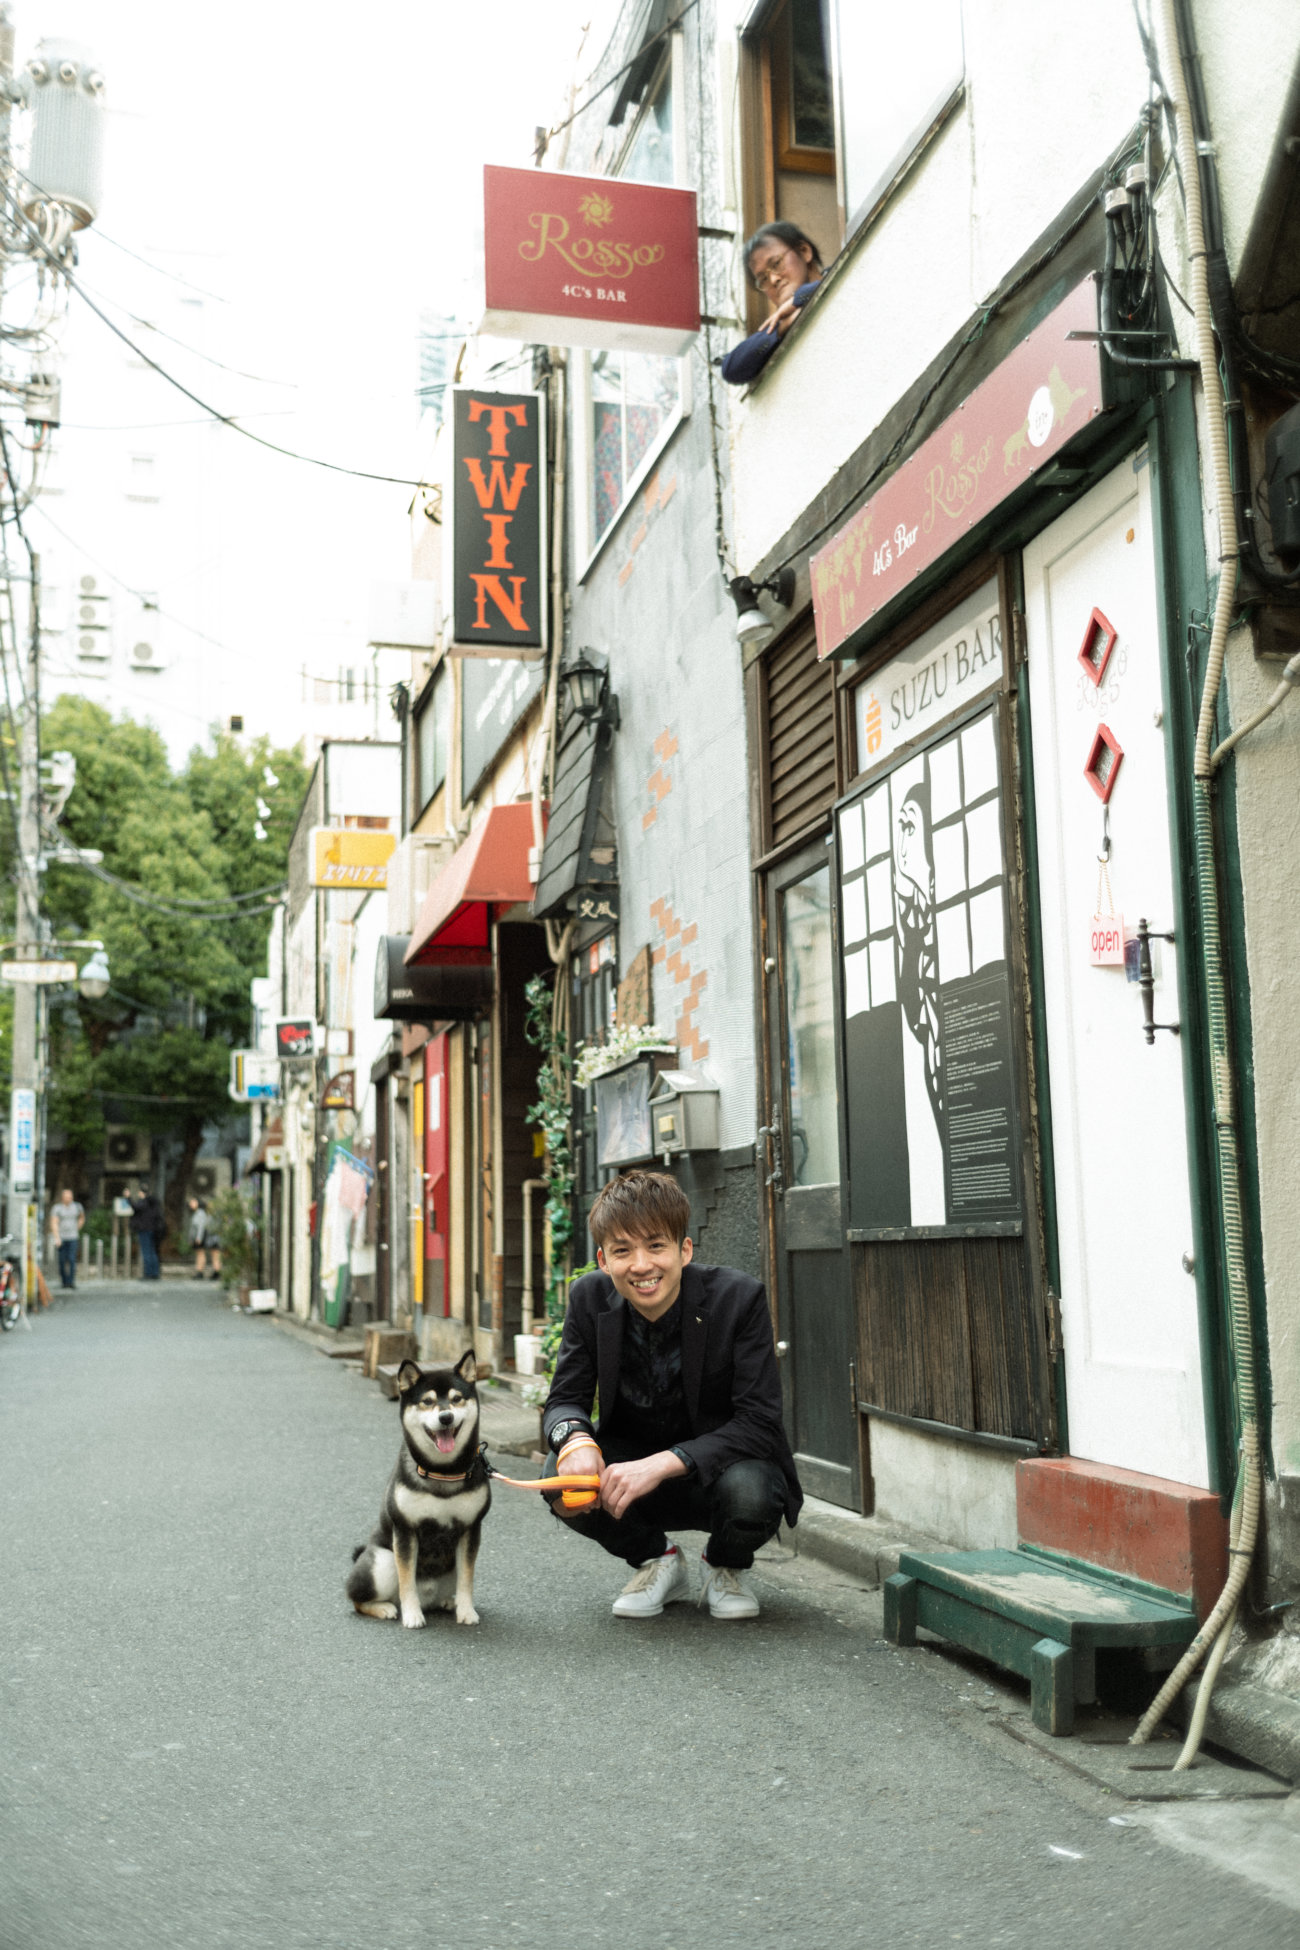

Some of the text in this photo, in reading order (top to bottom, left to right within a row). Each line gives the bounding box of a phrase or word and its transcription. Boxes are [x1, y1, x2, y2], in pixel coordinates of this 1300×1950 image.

[518, 213, 665, 278] Rosso
[562, 284, 627, 302] 4C's BAR
[462, 399, 533, 631] TWIN
[922, 435, 994, 533] Rosso
[894, 523, 919, 558] Bar
[890, 613, 1002, 731] SUZU BAR
[1091, 930, 1120, 961] open
